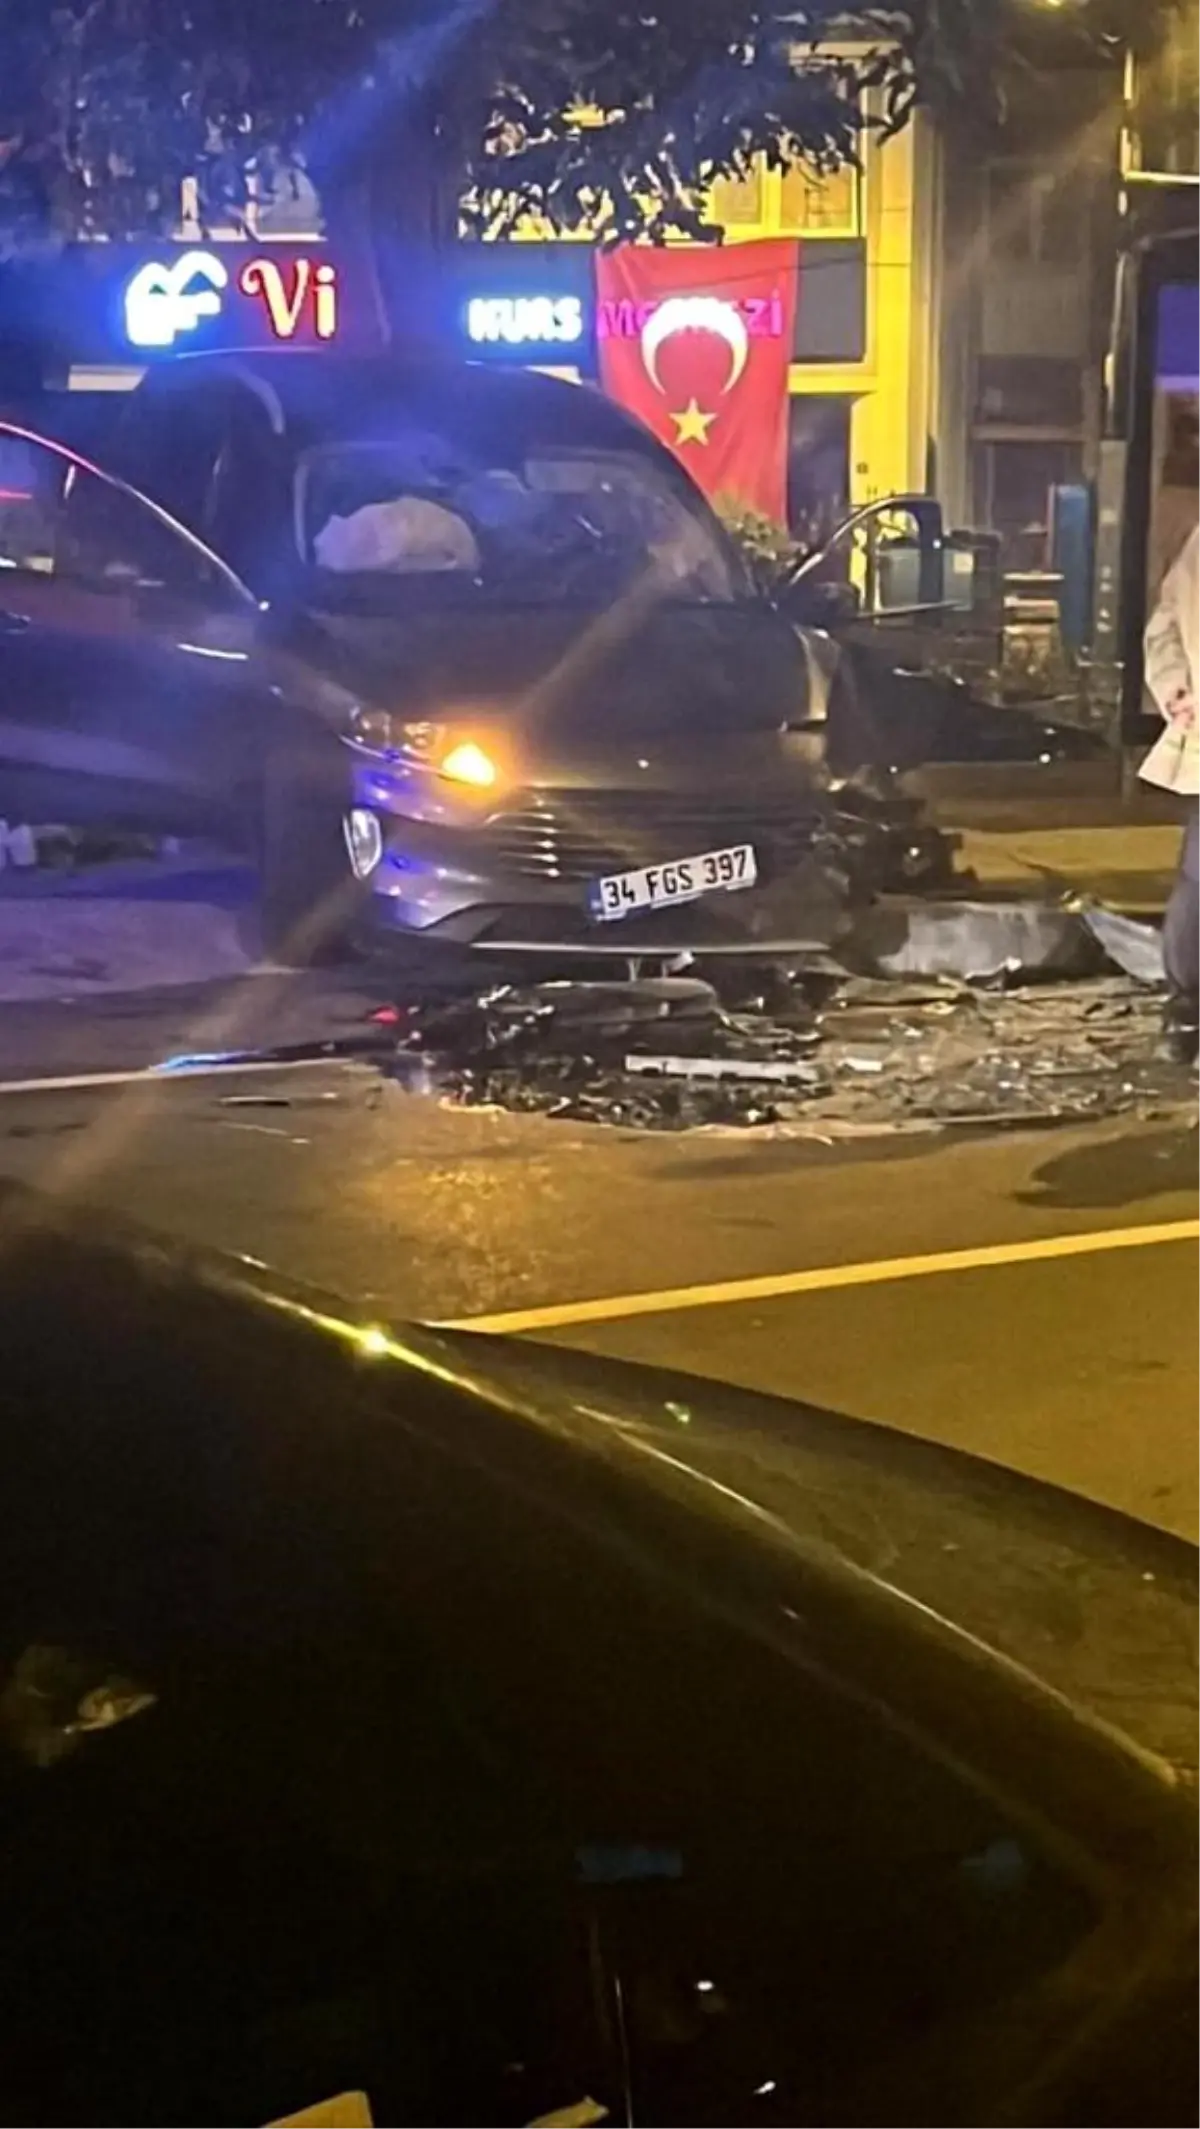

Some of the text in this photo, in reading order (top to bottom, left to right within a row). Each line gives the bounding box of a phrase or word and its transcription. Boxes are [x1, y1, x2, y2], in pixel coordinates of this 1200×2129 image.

[468, 296, 583, 343] KURS
[604, 849, 748, 908] 34 FGS 397
